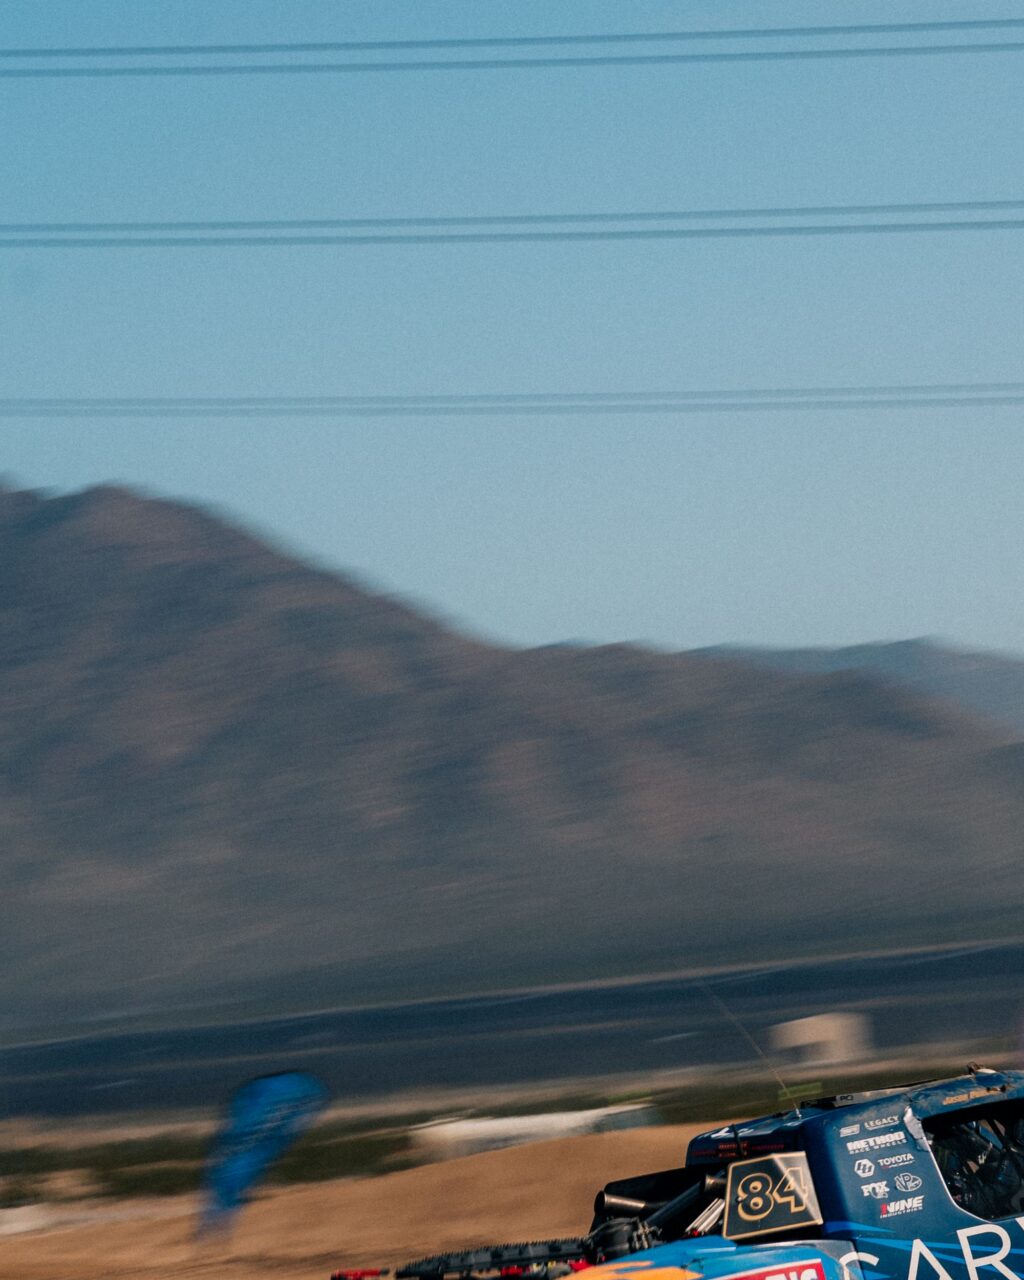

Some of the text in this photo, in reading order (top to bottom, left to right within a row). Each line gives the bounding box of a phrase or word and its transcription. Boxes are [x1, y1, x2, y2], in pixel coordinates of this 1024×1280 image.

[864, 1115, 899, 1128] LEGACY
[846, 1131, 906, 1151] METHOD
[877, 1153, 914, 1167] TOYOTA
[737, 1166, 809, 1221] 84
[861, 1180, 890, 1197] FOX
